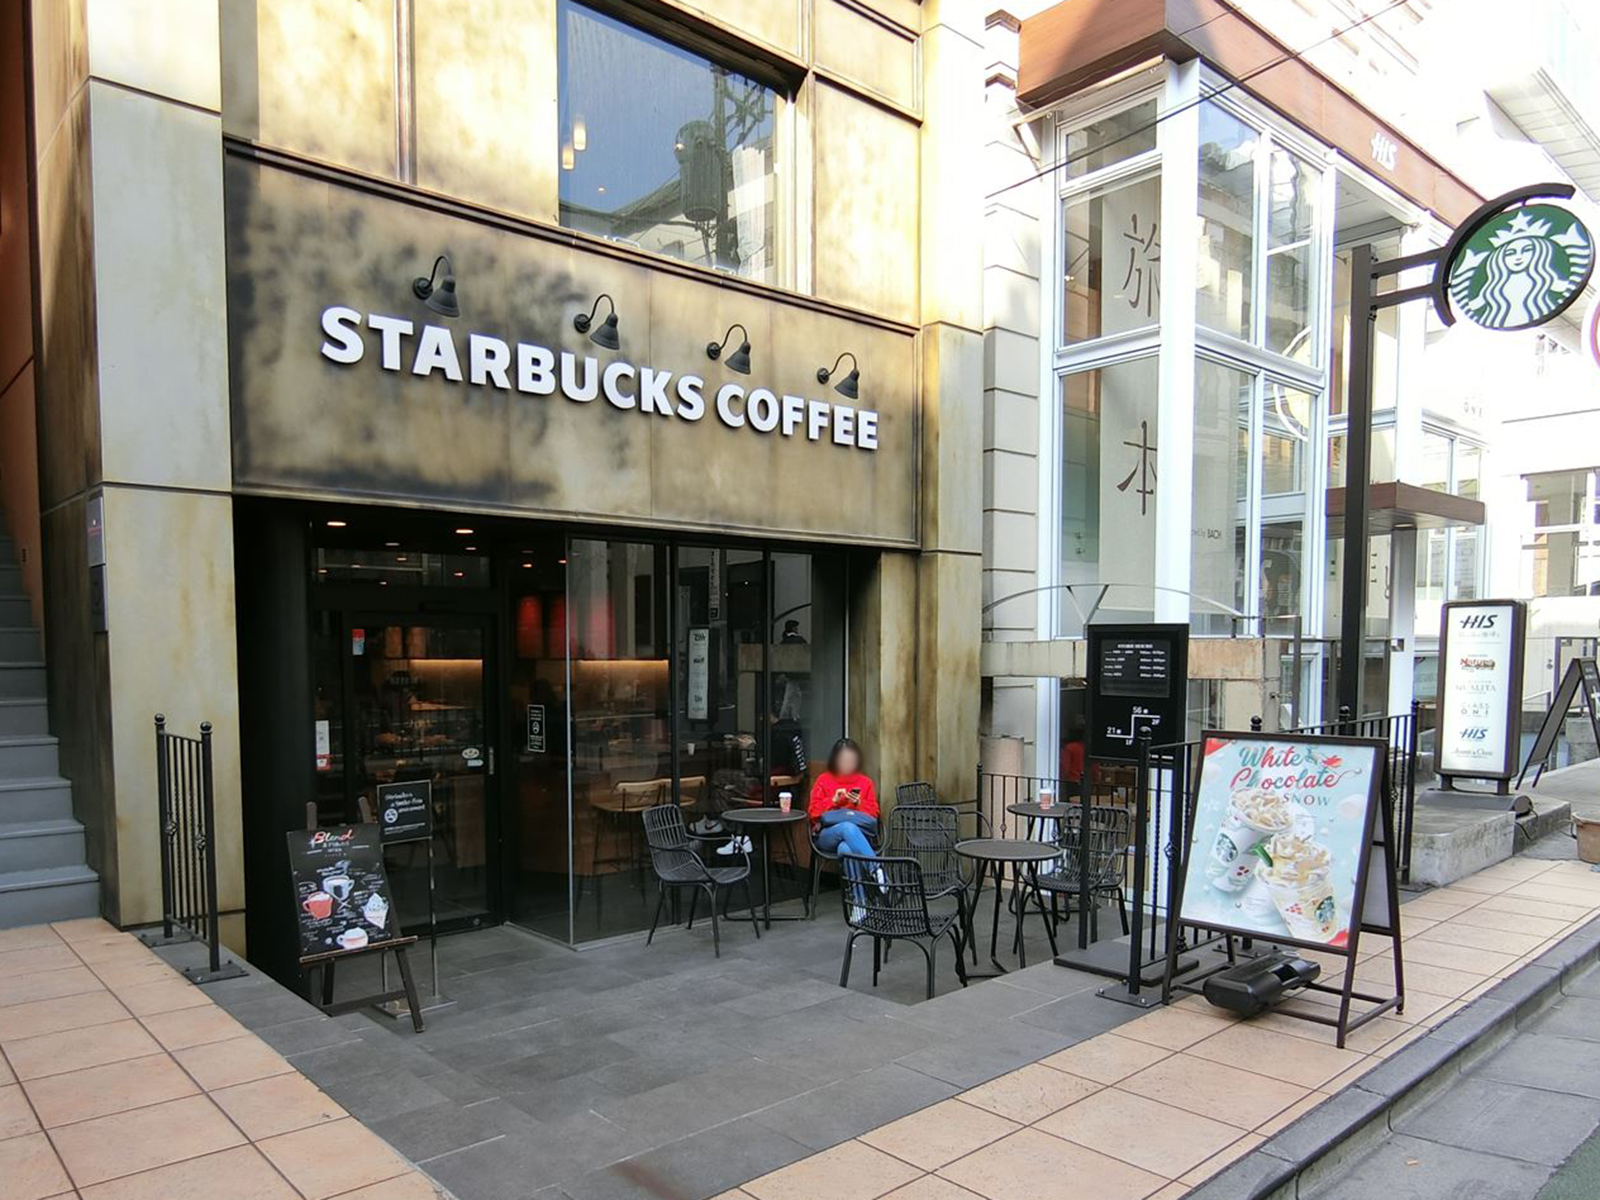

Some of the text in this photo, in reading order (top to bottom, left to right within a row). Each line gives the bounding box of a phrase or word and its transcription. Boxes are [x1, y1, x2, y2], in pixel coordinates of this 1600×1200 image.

[320, 305, 880, 451] STARBUCKS COFFEE
[1460, 614, 1498, 629] HIS
[1460, 729, 1488, 739] HIS
[1239, 745, 1304, 768] White
[1229, 766, 1339, 790] Chocolate
[1283, 793, 1331, 806] SNOW
[313, 828, 355, 844] Blend
